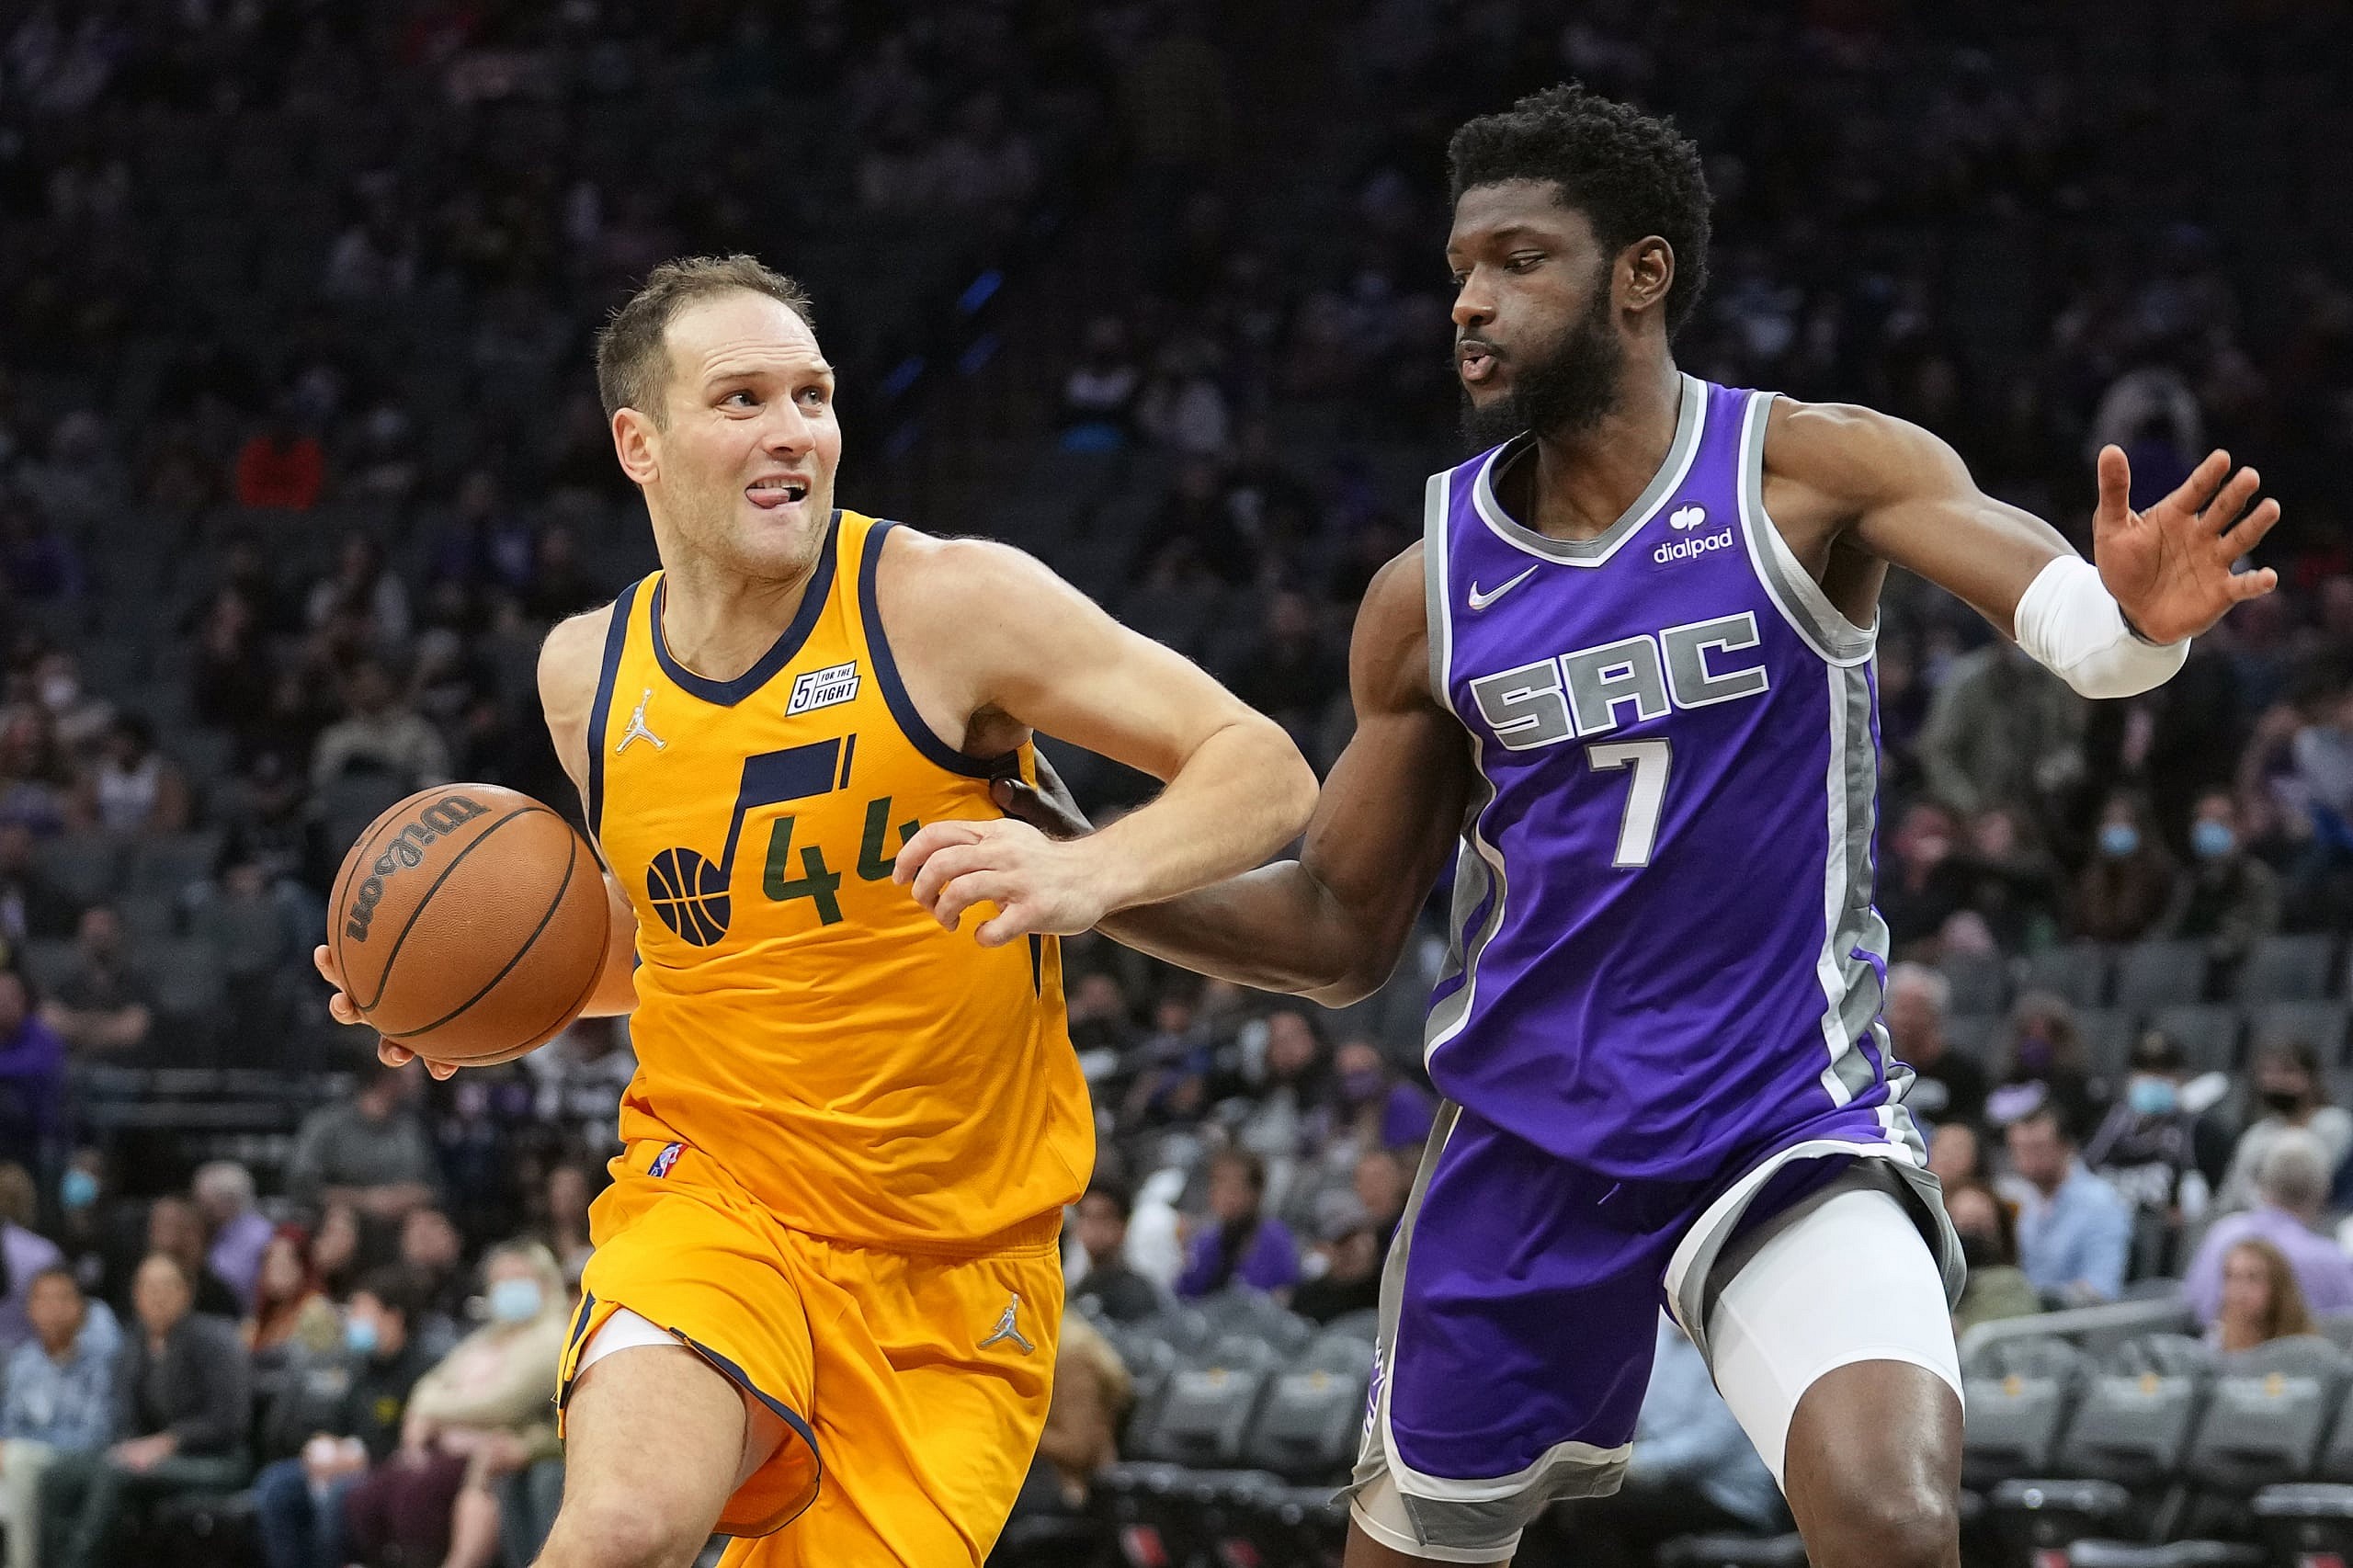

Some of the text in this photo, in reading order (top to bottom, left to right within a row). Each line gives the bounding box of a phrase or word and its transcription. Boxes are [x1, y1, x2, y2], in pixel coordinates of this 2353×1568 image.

[1654, 528, 1733, 564] dialpad
[793, 676, 814, 709] 5
[821, 667, 851, 682] FOR THE
[1469, 610, 1770, 751] SAC
[814, 682, 855, 704] FIGHT
[1583, 737, 1673, 869] 7
[346, 795, 493, 943] Wilson
